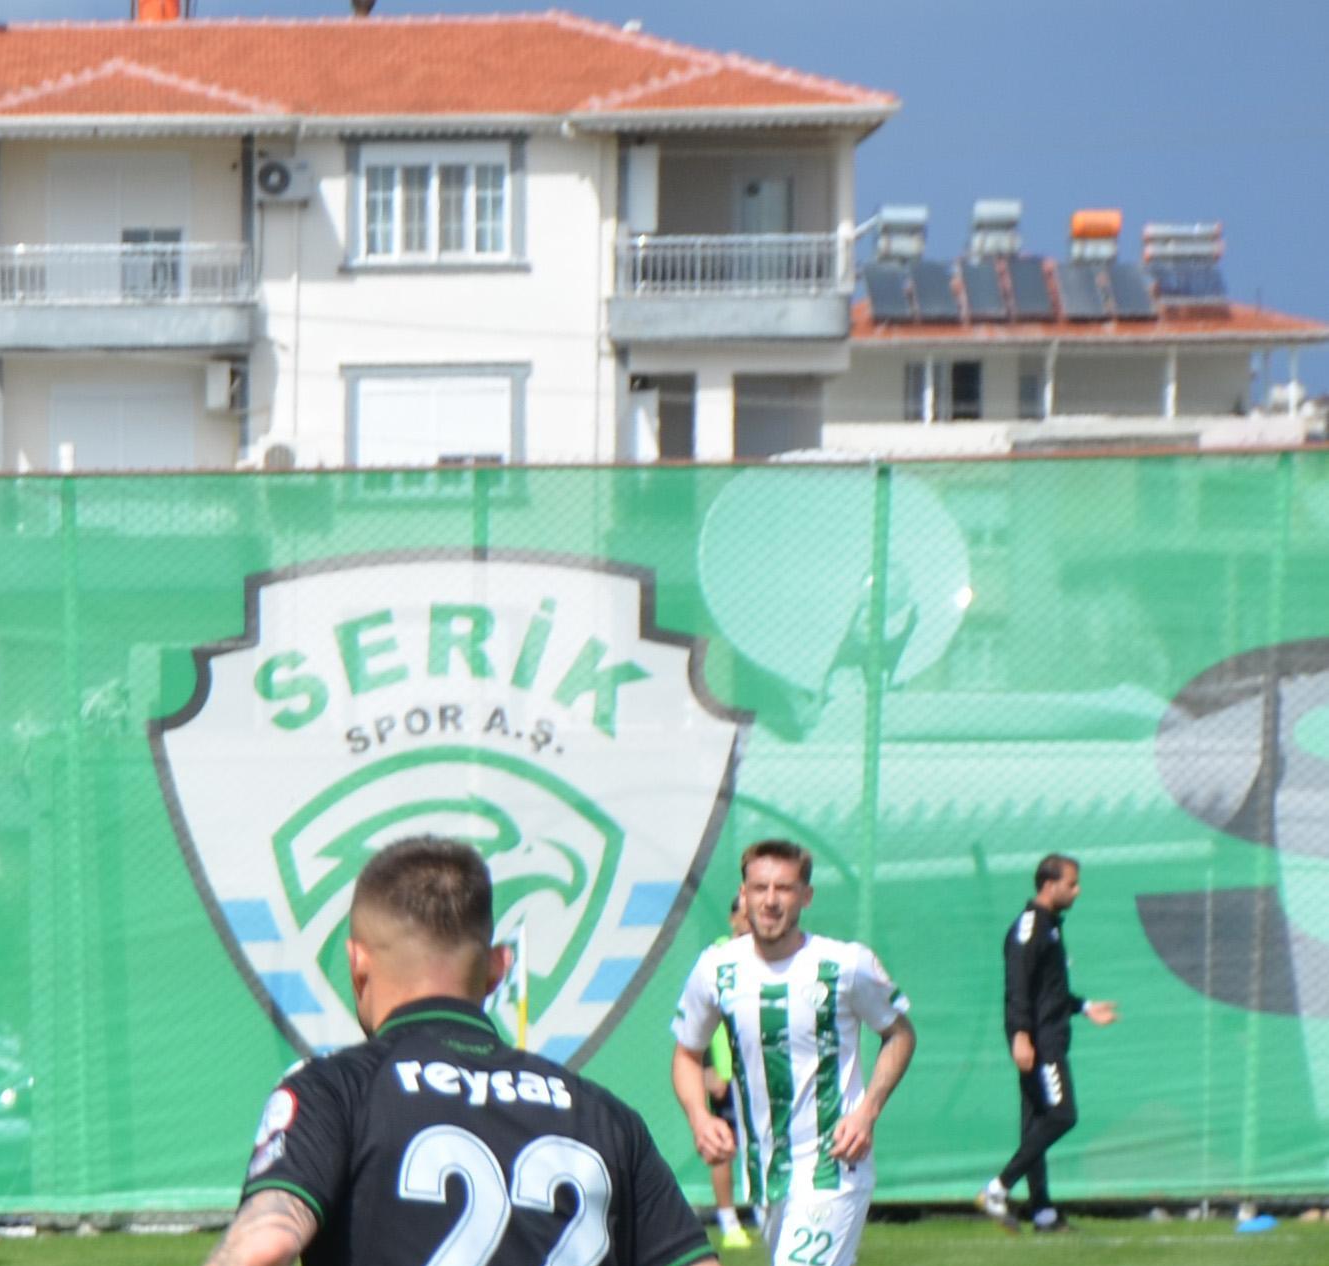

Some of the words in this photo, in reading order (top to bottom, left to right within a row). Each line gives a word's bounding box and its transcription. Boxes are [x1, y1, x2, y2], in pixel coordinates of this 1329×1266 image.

[253, 597, 653, 740] SERİK
[345, 703, 464, 755] SPOR
[483, 706, 566, 756] A.Ş.
